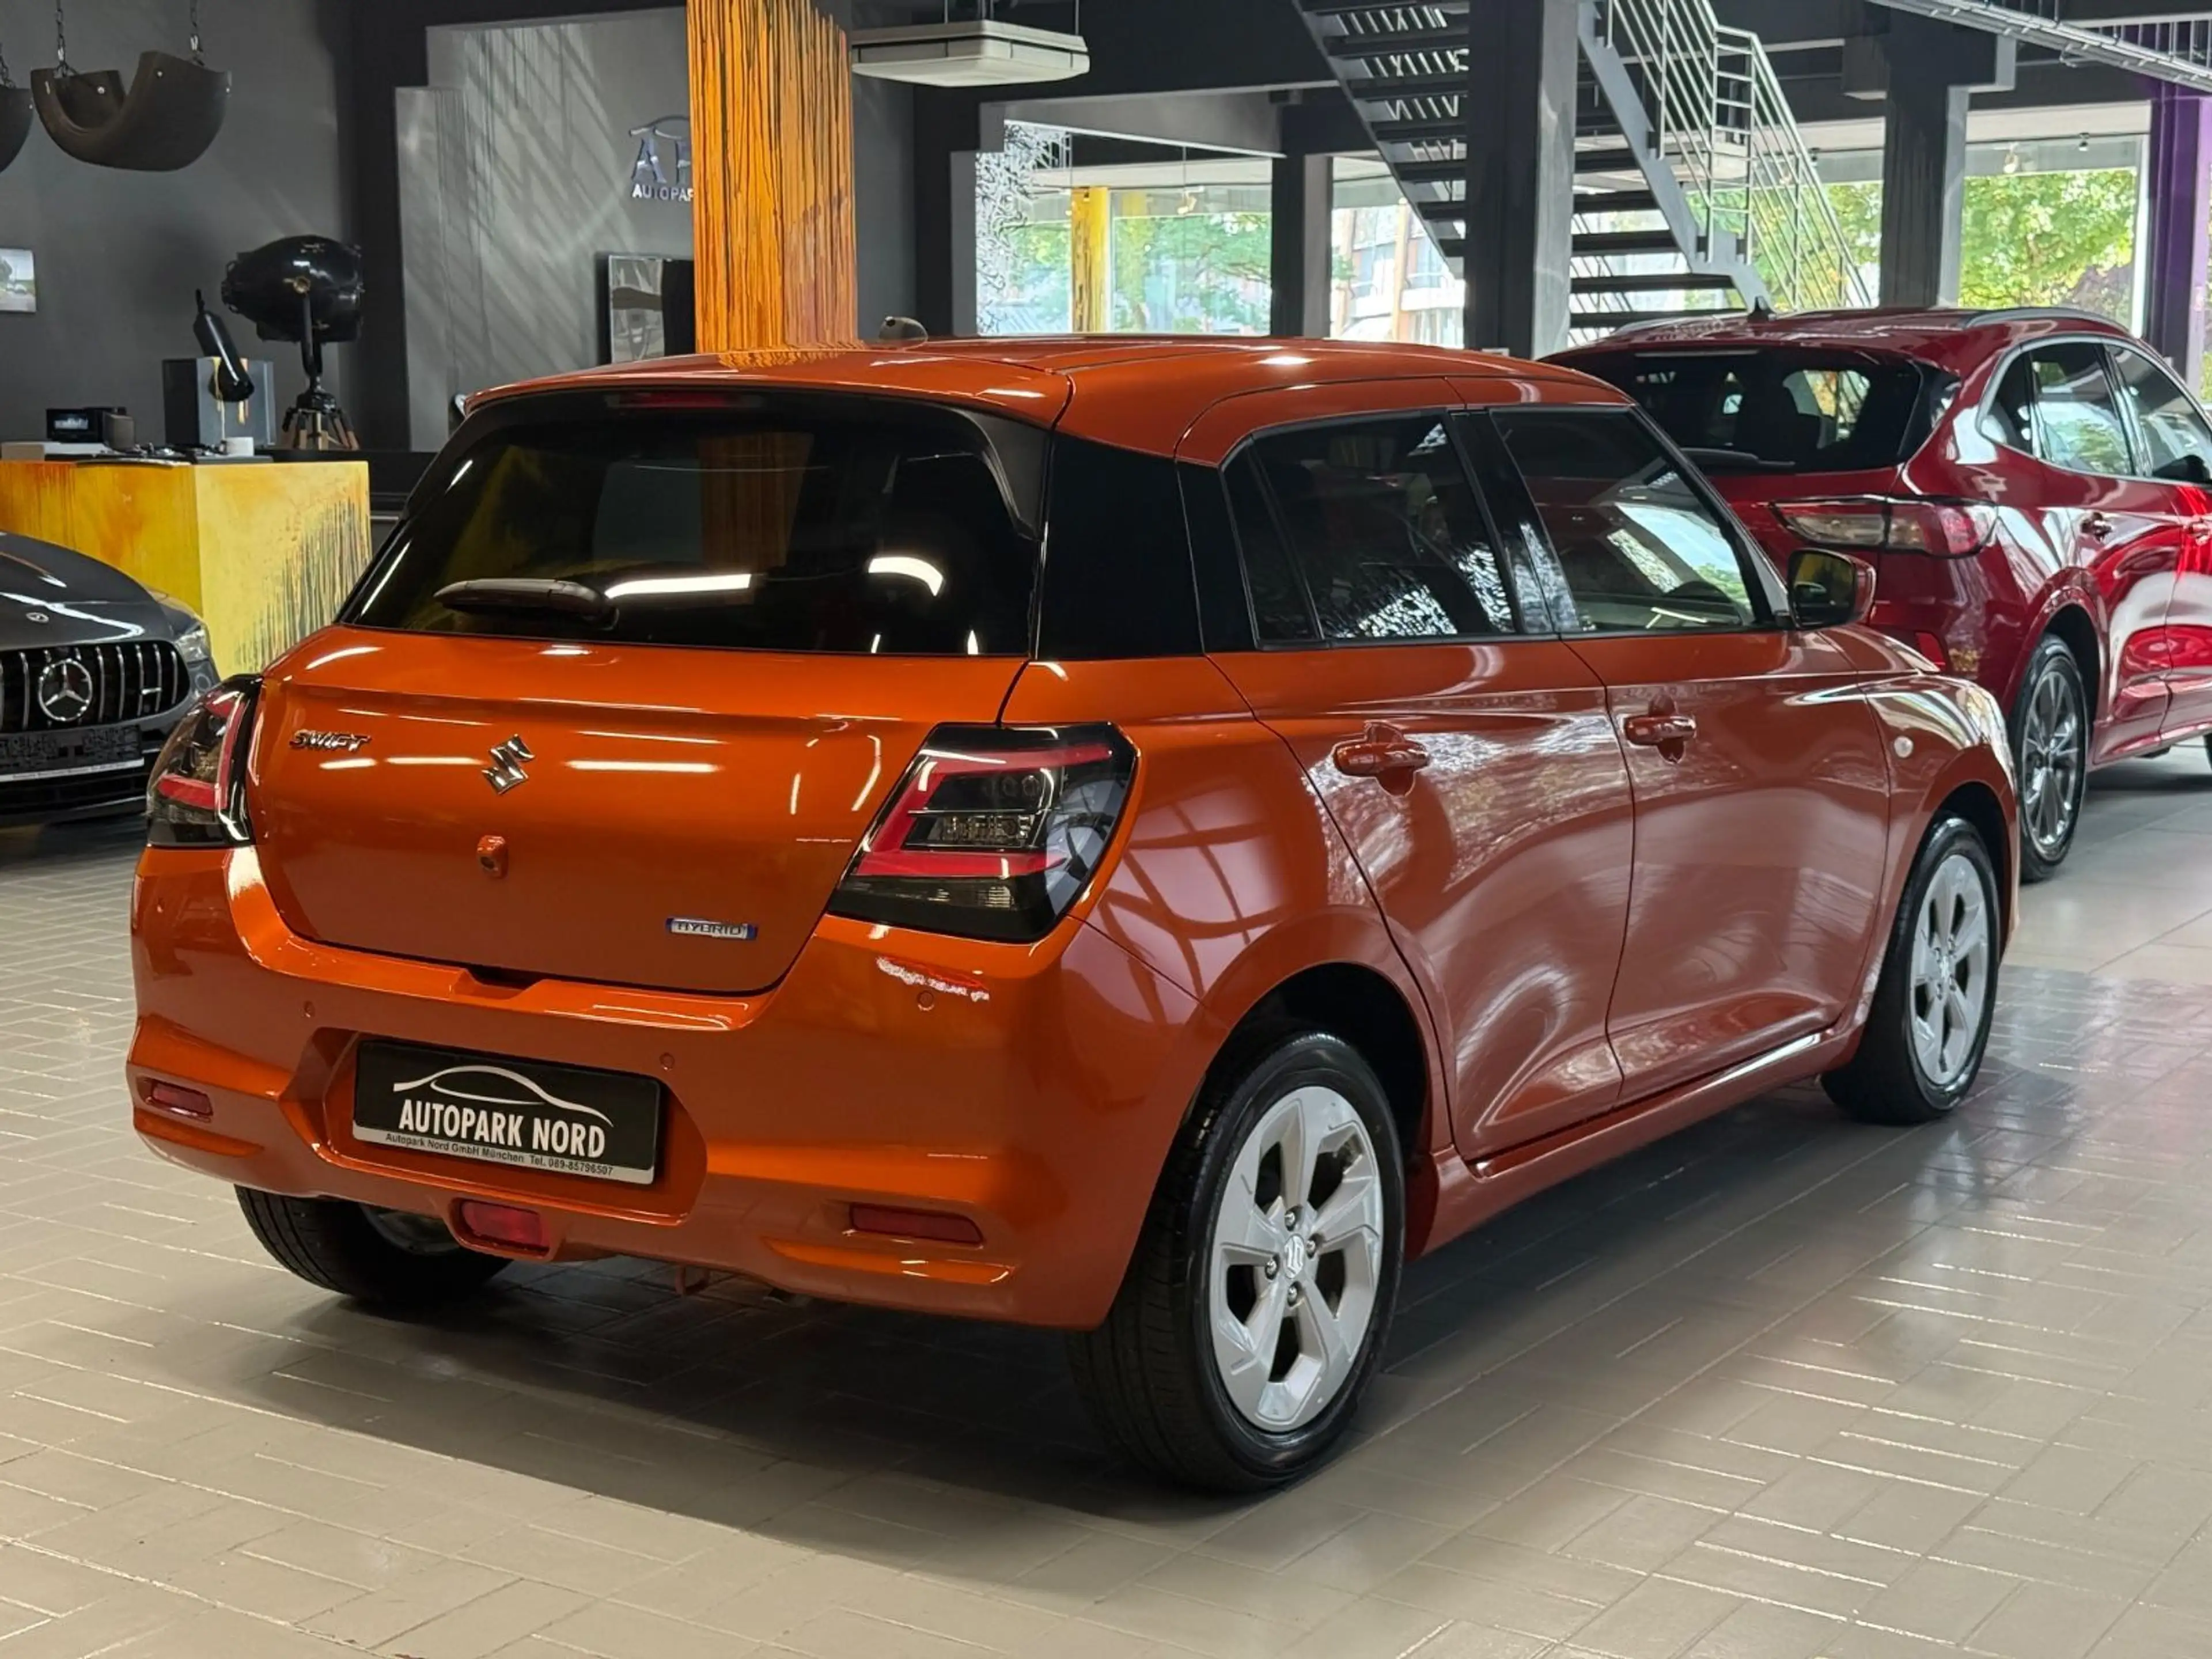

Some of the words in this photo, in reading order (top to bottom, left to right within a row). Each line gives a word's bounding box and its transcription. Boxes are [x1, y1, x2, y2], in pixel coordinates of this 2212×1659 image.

[289, 729, 372, 752] SWIFT
[677, 922, 741, 935] HYBRID
[399, 1099, 523, 1147] AUTOPARK
[532, 1117, 605, 1158] NORD
[385, 1132, 425, 1147] Autopark
[427, 1139, 449, 1151] Nord
[452, 1143, 480, 1156] GmbH
[482, 1147, 524, 1162] München
[530, 1155, 546, 1166] Tel.
